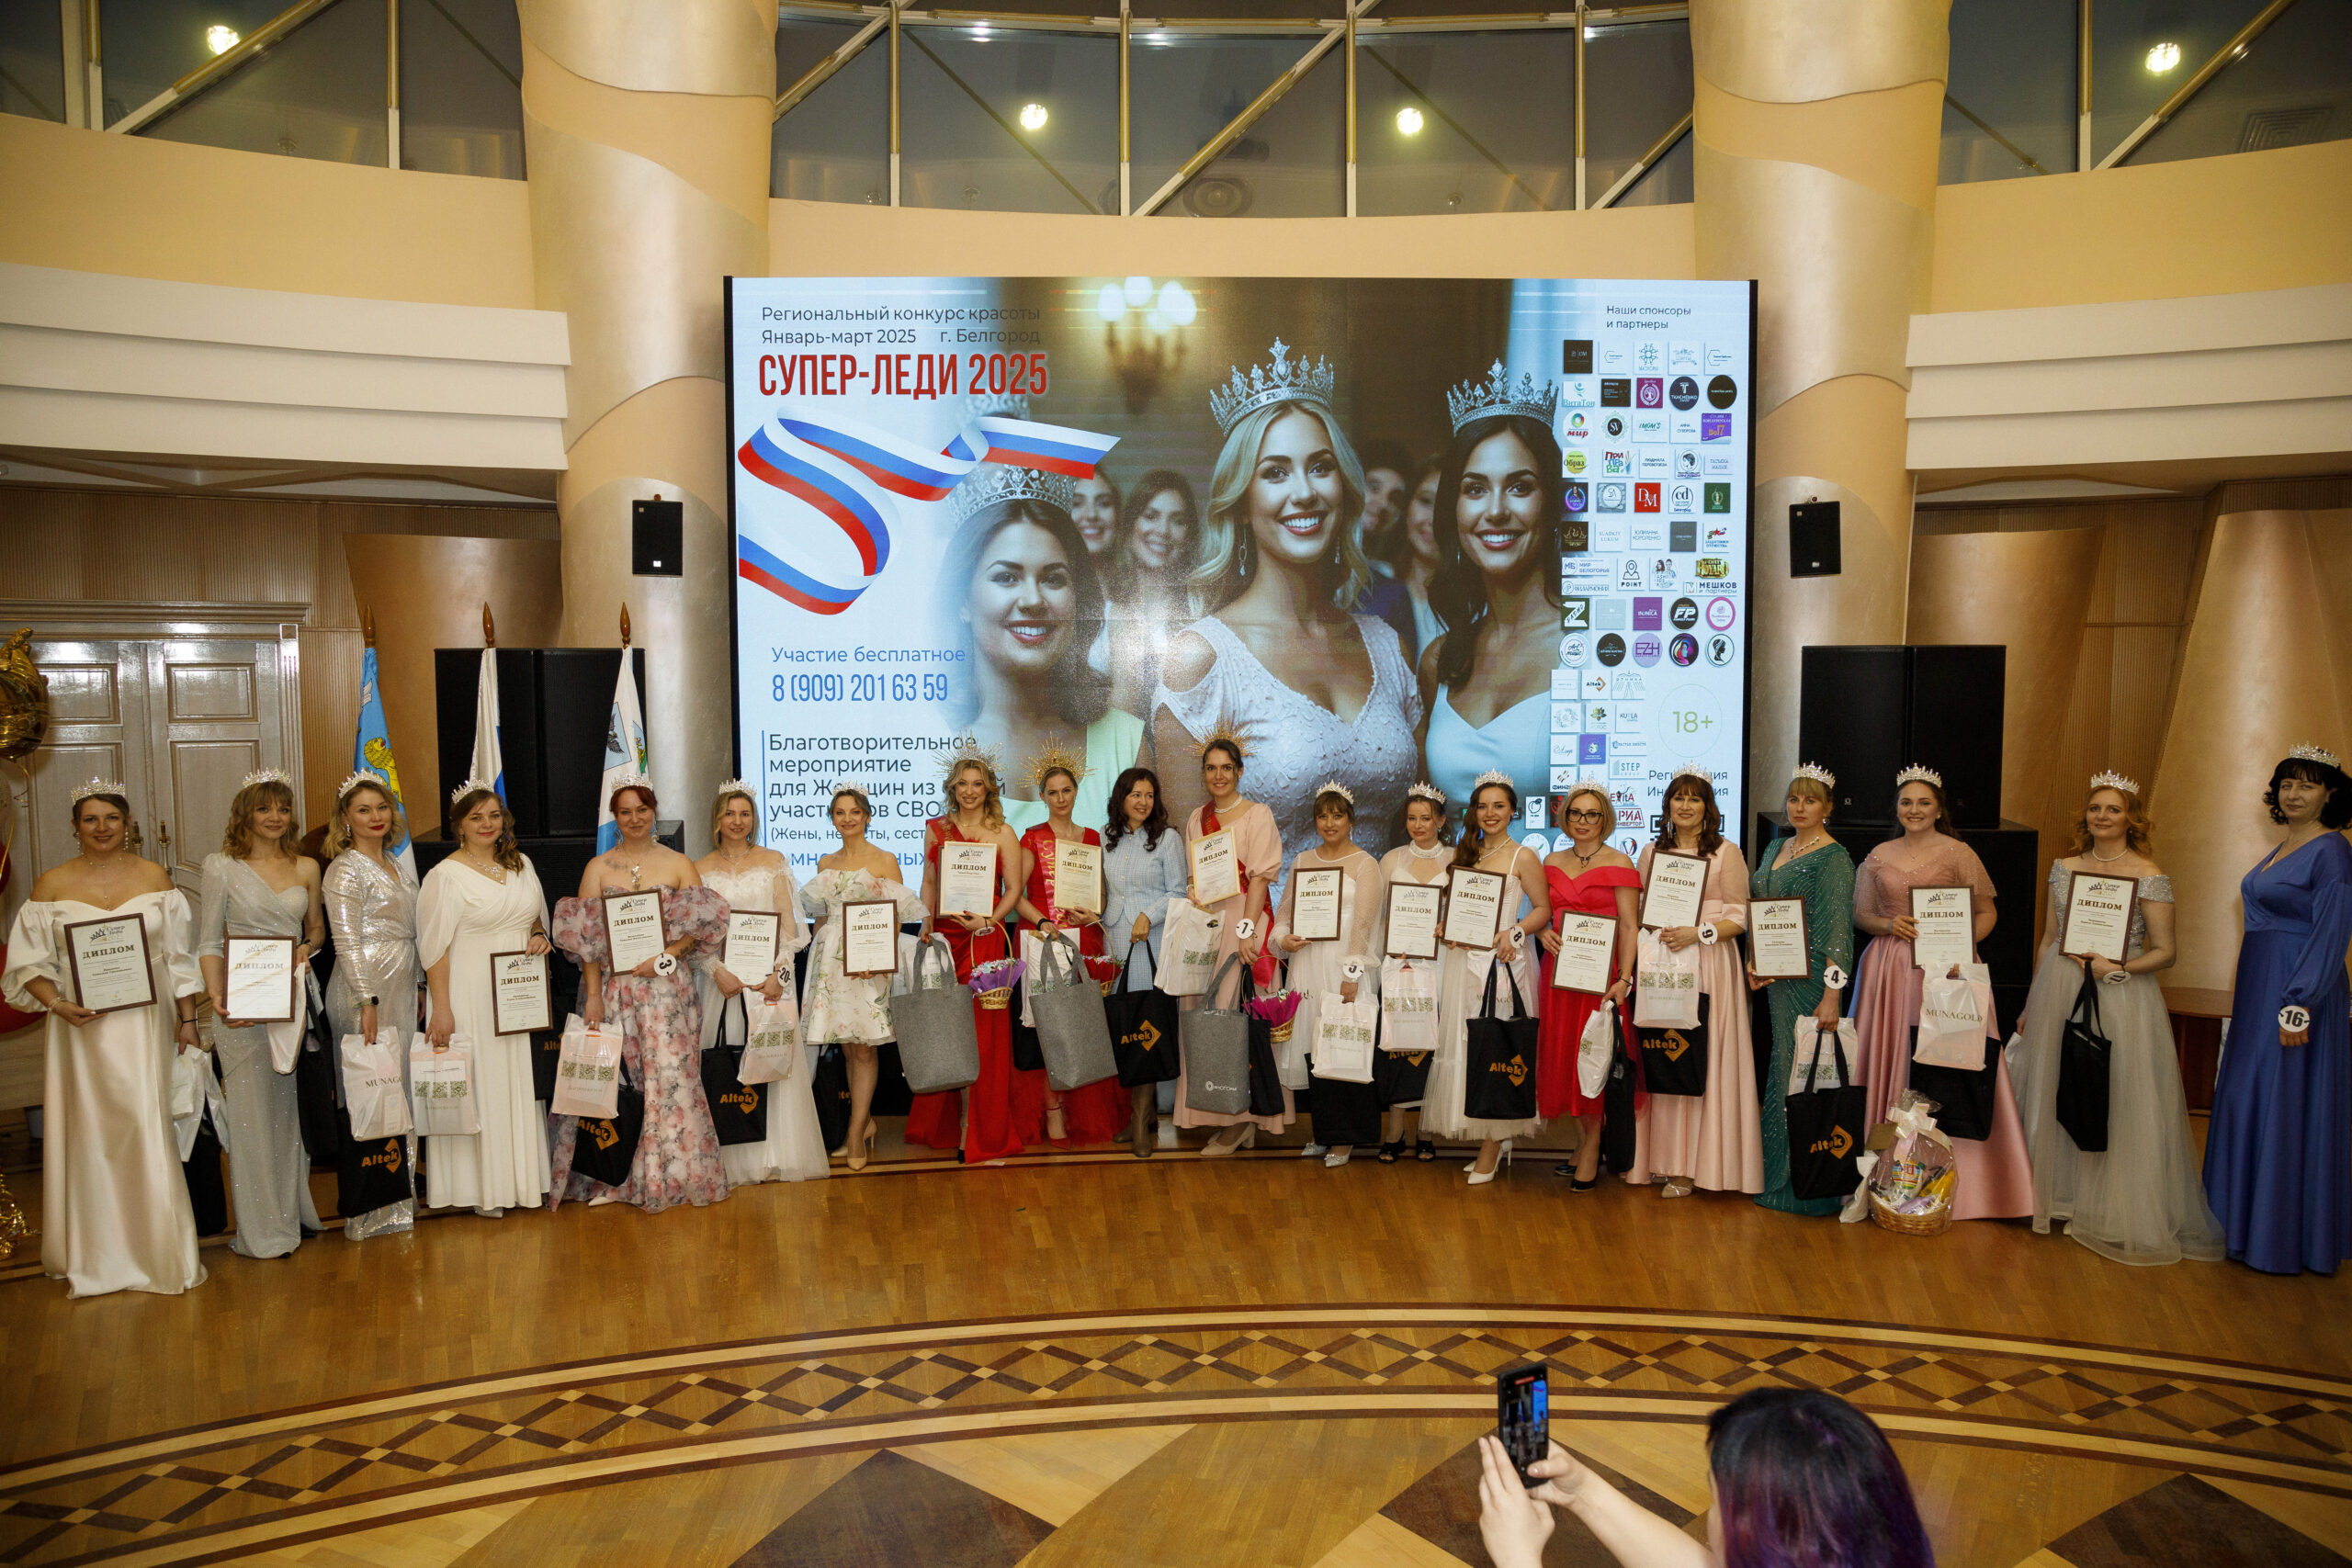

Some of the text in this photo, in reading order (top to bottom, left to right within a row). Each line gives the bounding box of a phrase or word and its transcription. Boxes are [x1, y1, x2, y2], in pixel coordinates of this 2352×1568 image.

[762, 306, 1040, 323] Региональный конкурс красоты
[1607, 306, 1691, 318] Наши спонсоры
[1616, 321, 1668, 331] партнеры
[762, 329, 1040, 346] Январь-март 2025 г. Белгород
[759, 353, 1047, 400] СУПЕР-ЛЕДИ 2025
[772, 646, 966, 663] Участие бесплатное
[773, 672, 948, 702] 8 (909) 201 63 59
[1672, 710, 1713, 734] 18+
[769, 734, 977, 754] Благотворительное
[770, 760, 911, 776] мероприятие
[769, 783, 806, 798] для
[813, 779, 904, 797] Жщин
[912, 783, 935, 795] из
[770, 801, 941, 822] участов СВО
[771, 827, 926, 841] (Жены, несты, сест
[1198, 849, 1228, 864] ДИПЛОМ
[951, 863, 987, 872] ДИПЛОМ
[1061, 860, 1093, 871] ДИПЛОМ
[1656, 874, 1696, 887] ДИПЛОМ
[1457, 891, 1496, 903] ДИПЛОМ
[1395, 905, 1432, 914] ДИПЛОМ
[2076, 898, 2122, 911] ДИПЛОМ
[614, 915, 655, 926] ДИПЛОМ
[1920, 911, 1964, 919] ДИПЛОМ
[851, 923, 888, 931] ДИПЛОМ
[1241, 922, 1249, 934] 7
[731, 933, 770, 942] ДИПЛОМ
[1513, 931, 1522, 942] 8
[1566, 935, 1606, 946] ДИПЛОМ
[82, 944, 135, 959] ДИПЛОМ
[501, 976, 539, 986] ДИПЛОМ
[779, 966, 791, 984] 20
[1831, 970, 1839, 984] 4
[1925, 1009, 1984, 1022] MUNAGOLD
[2284, 1010, 2304, 1028] 16
[1121, 1031, 1150, 1044] Altek
[1643, 1038, 1678, 1050] Altek
[544, 1040, 560, 1051] Alt
[1488, 1062, 1521, 1076] Altek
[719, 1093, 752, 1104] Altek
[578, 1119, 608, 1139] Altek
[1810, 1137, 1843, 1153] Altek
[361, 1148, 398, 1168] Altek
